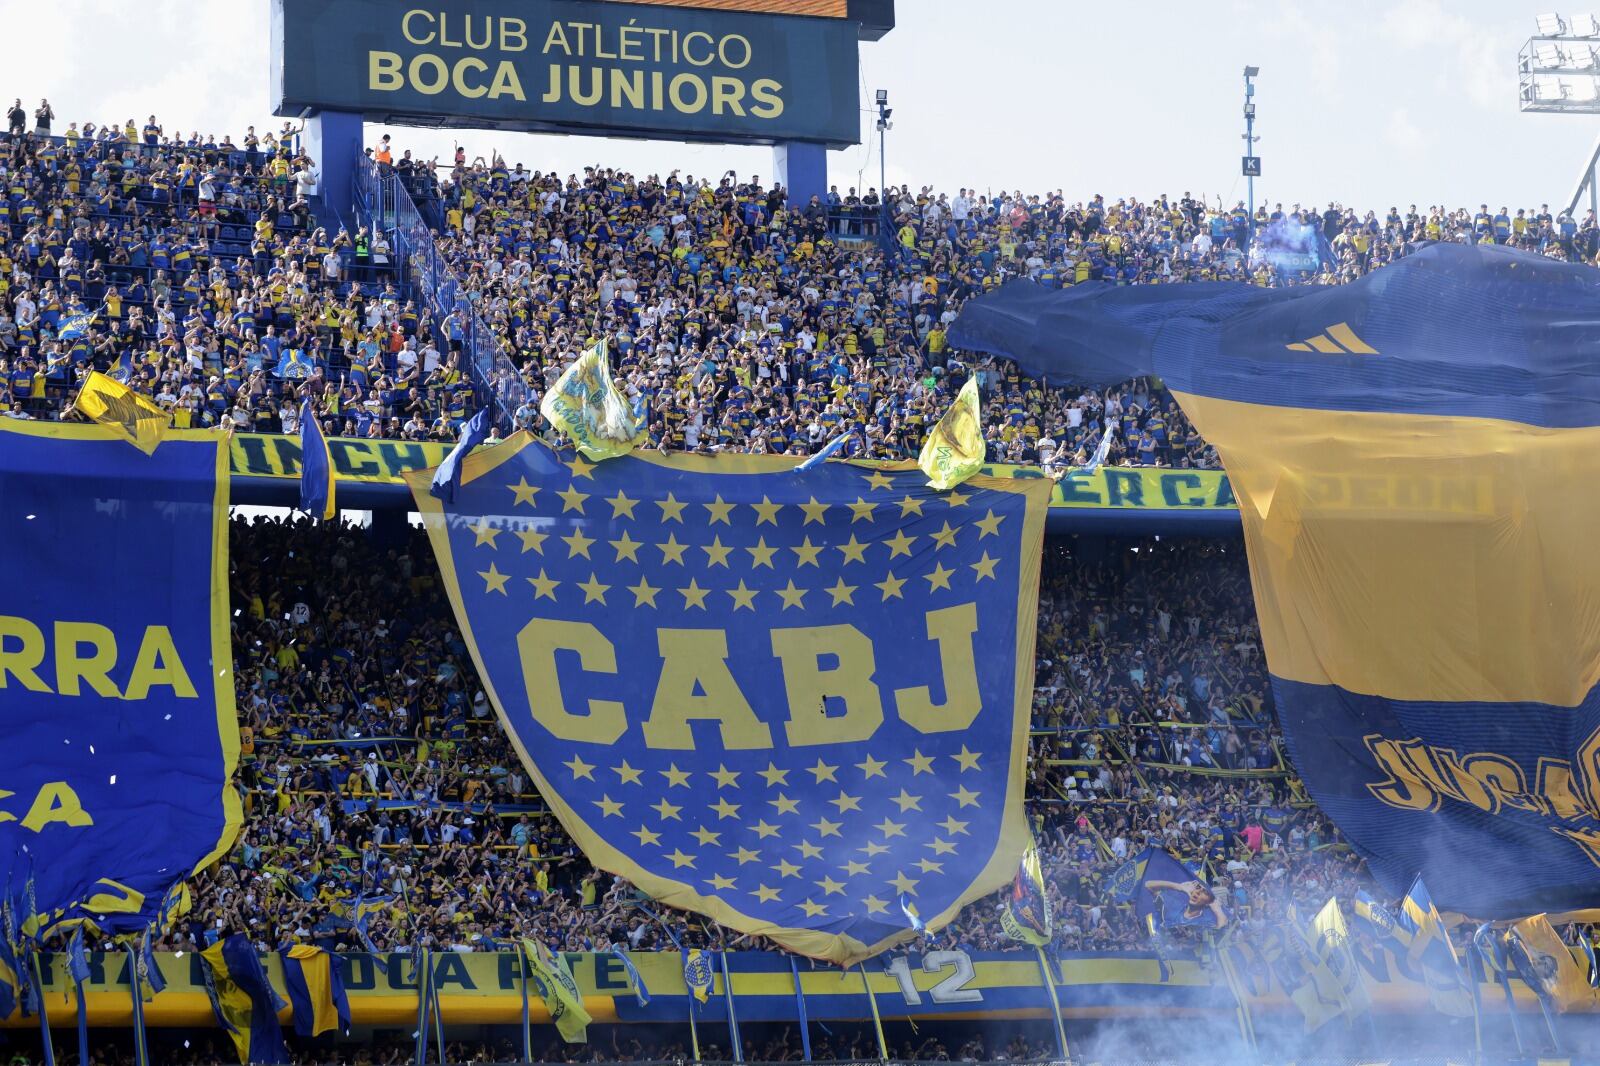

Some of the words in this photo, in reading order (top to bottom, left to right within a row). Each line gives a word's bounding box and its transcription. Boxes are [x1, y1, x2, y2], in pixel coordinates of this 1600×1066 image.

[401, 9, 528, 52] CLUB
[542, 19, 752, 69] ATLÉTICO
[368, 50, 526, 101] BOCA
[542, 64, 784, 119] JUNIORS
[1247, 159, 1256, 169] K
[230, 437, 448, 478] INCH
[296, 606, 307, 615] 12
[516, 602, 983, 750] CABJ
[0, 781, 95, 833] A
[884, 951, 984, 1005] 12
